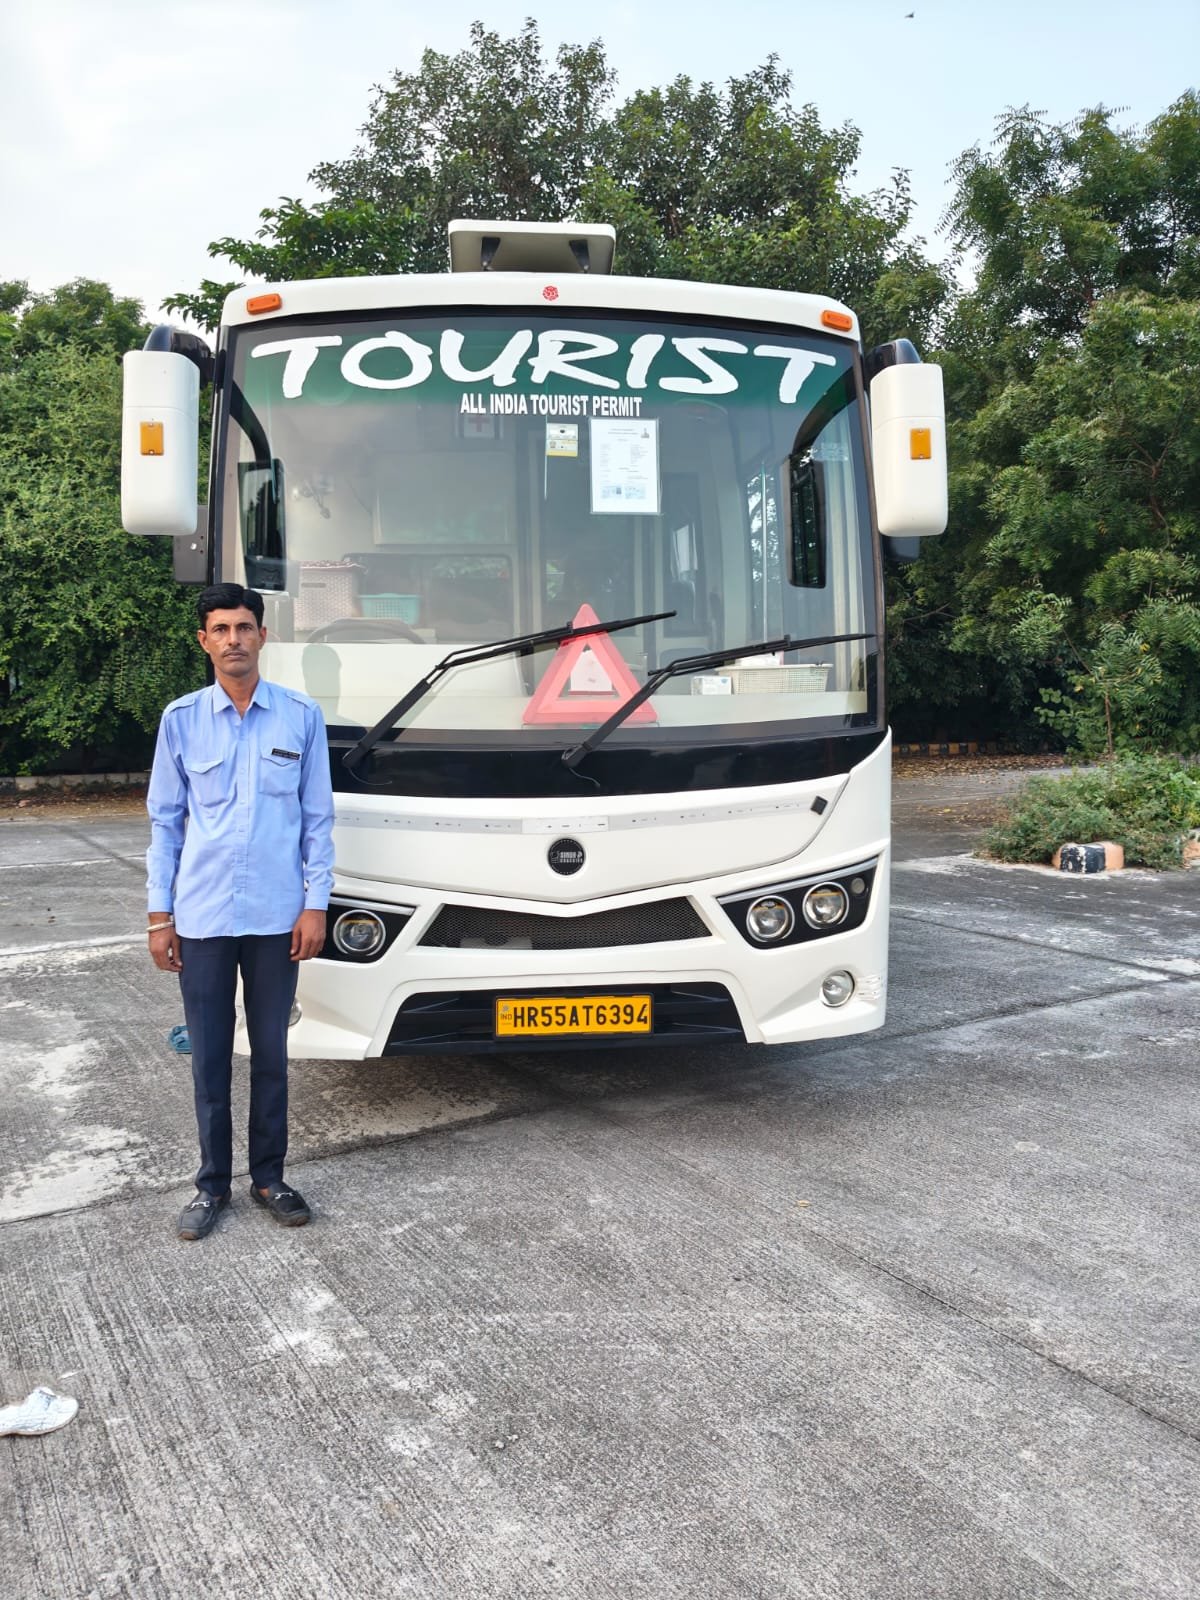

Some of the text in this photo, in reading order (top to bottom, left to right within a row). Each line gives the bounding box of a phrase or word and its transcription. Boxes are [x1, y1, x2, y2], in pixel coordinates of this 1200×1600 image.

[251, 329, 837, 405] TOURIST
[460, 393, 643, 417] ALL INDIA TOURIST PERMIT
[513, 1003, 648, 1028] HR55AT6394
